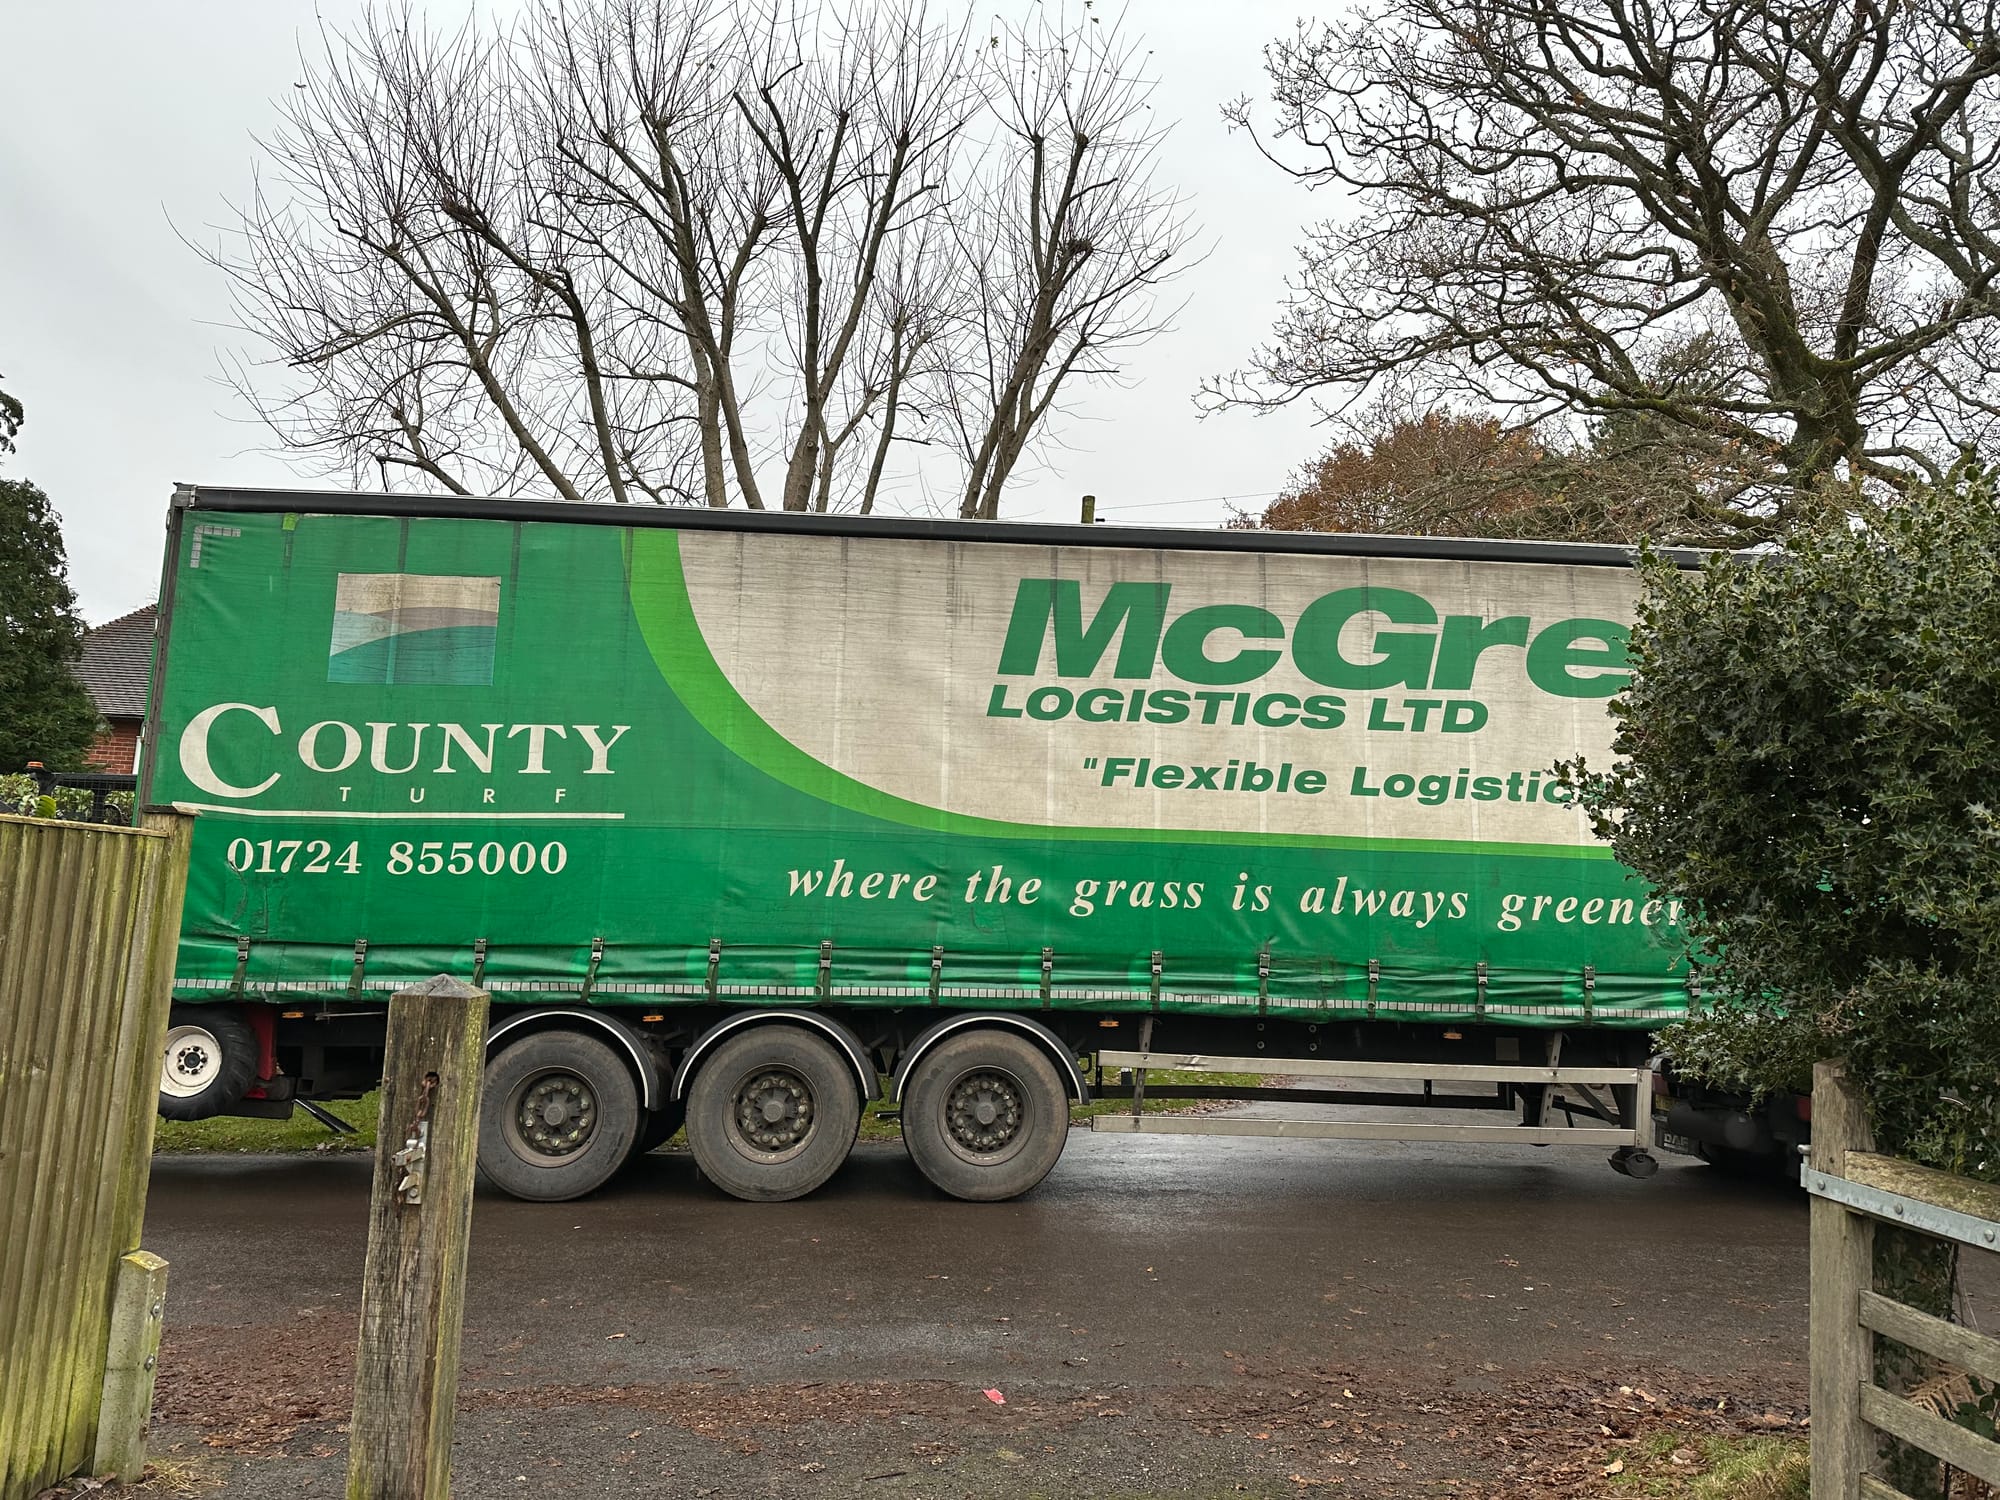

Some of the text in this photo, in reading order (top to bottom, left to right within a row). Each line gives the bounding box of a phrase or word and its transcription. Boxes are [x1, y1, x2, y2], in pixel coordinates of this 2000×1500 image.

[997, 578, 1641, 700] McGre
[986, 684, 1489, 733] LOGISTICS LTD
[179, 702, 632, 799] COUNTY
[339, 786, 567, 804] TURF
[1083, 757, 1327, 795] "Flexible
[227, 837, 567, 875] 01724 855000
[787, 858, 938, 902] where
[964, 864, 1042, 905] the
[1069, 879, 1205, 917] grass
[1232, 872, 1272, 912] is
[1299, 876, 1469, 929] always
